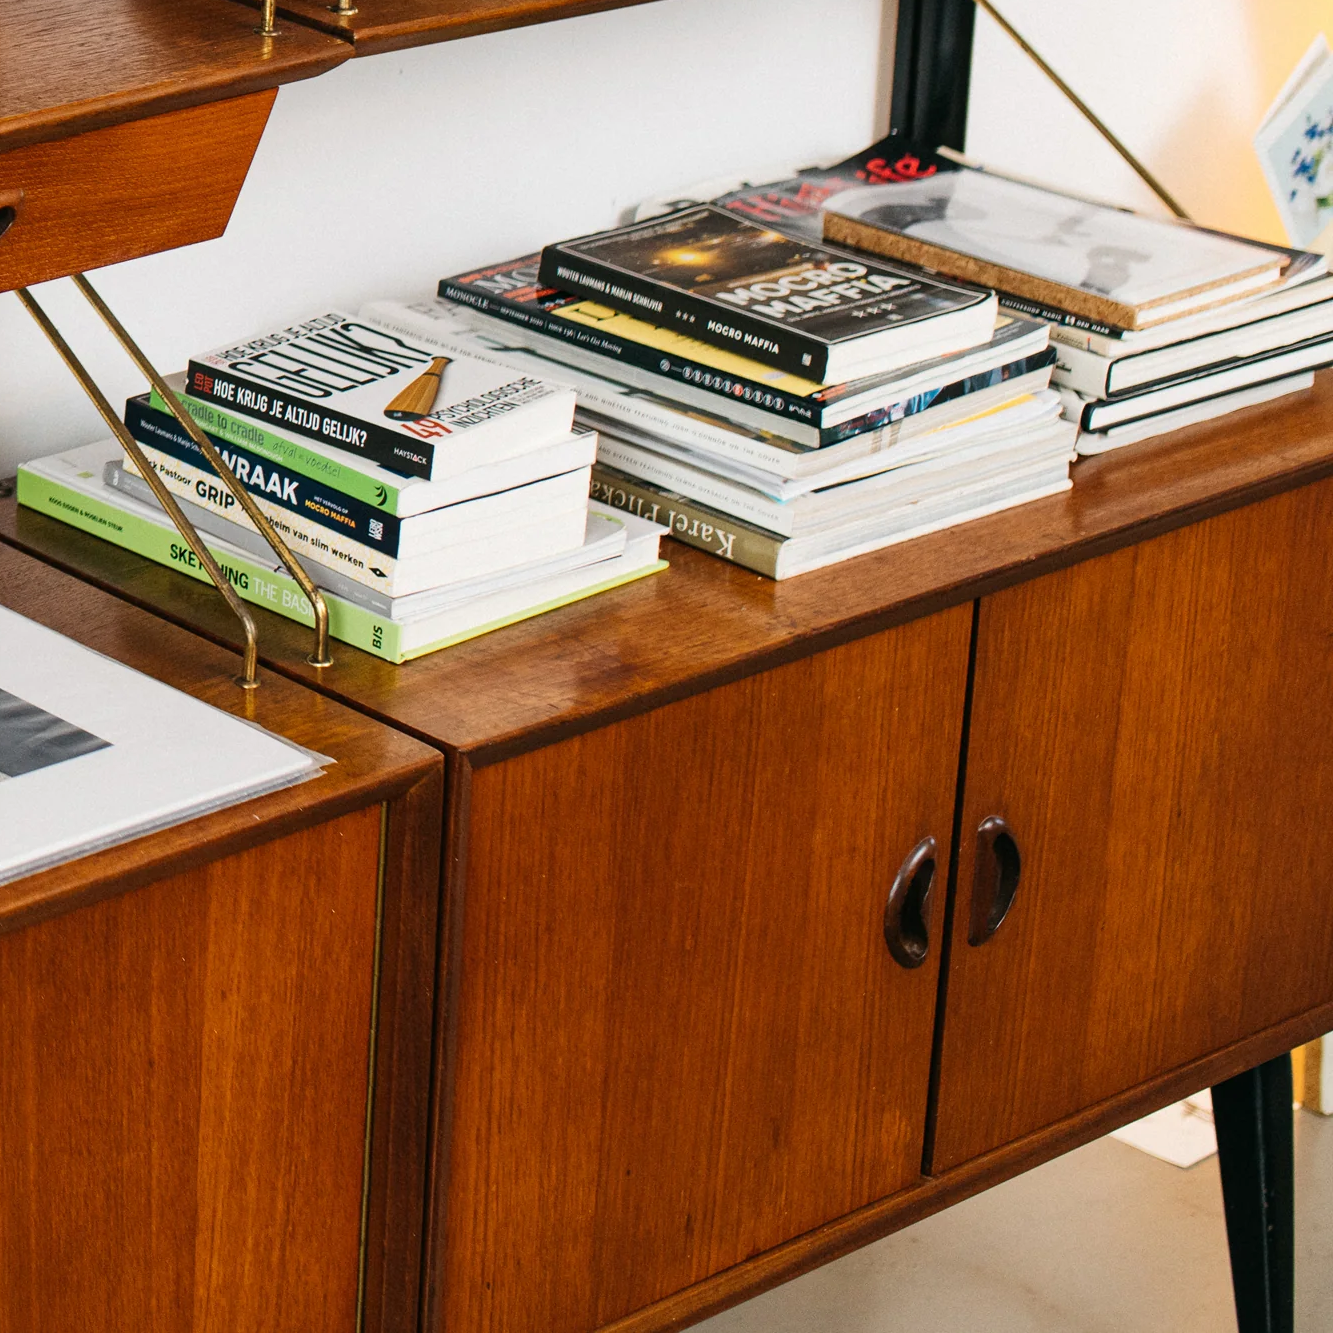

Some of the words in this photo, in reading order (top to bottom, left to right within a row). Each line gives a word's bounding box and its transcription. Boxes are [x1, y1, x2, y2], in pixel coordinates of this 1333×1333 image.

[444, 286, 490, 310] MONOCLE
[716, 262, 868, 306] MOCRO
[751, 274, 913, 319] MAFFIA
[556, 266, 579, 284] WOUTER
[579, 274, 605, 293] LAUMANS
[610, 284, 633, 302] MARIJN
[633, 292, 663, 313] SCHRIJVER
[707, 320, 743, 341] MOCRO
[744, 332, 780, 356] MAFFIA
[216, 342, 248, 362] HOE
[243, 332, 284, 353] KRIJG
[297, 313, 347, 335] ALTIJD
[194, 371, 205, 391] LEO
[228, 322, 433, 399] GELIJK?
[203, 375, 214, 395] POT
[213, 378, 235, 401] HOE
[237, 387, 268, 416] KRIJG
[268, 398, 283, 419] JE
[284, 404, 320, 432] ALTIJD
[322, 419, 368, 448] GELIJK?
[393, 447, 428, 465] HAYSTACK
[217, 413, 227, 430] to
[230, 418, 264, 445] cradle
[401, 418, 453, 439] 49
[429, 376, 543, 422] PSYCHOLOGISCHE
[449, 401, 521, 429] INZICHTEN
[215, 446, 299, 506] WRAAK
[159, 463, 192, 488] Pastoor
[196, 479, 235, 511] GRIP
[293, 527, 309, 543] van
[311, 533, 329, 553] slim
[331, 546, 364, 570] werken
[304, 499, 330, 517] MOCRO
[331, 511, 356, 529] MAFFIA
[669, 510, 737, 560] Karel
[253, 577, 278, 603] THE
[372, 625, 383, 650] BIS
